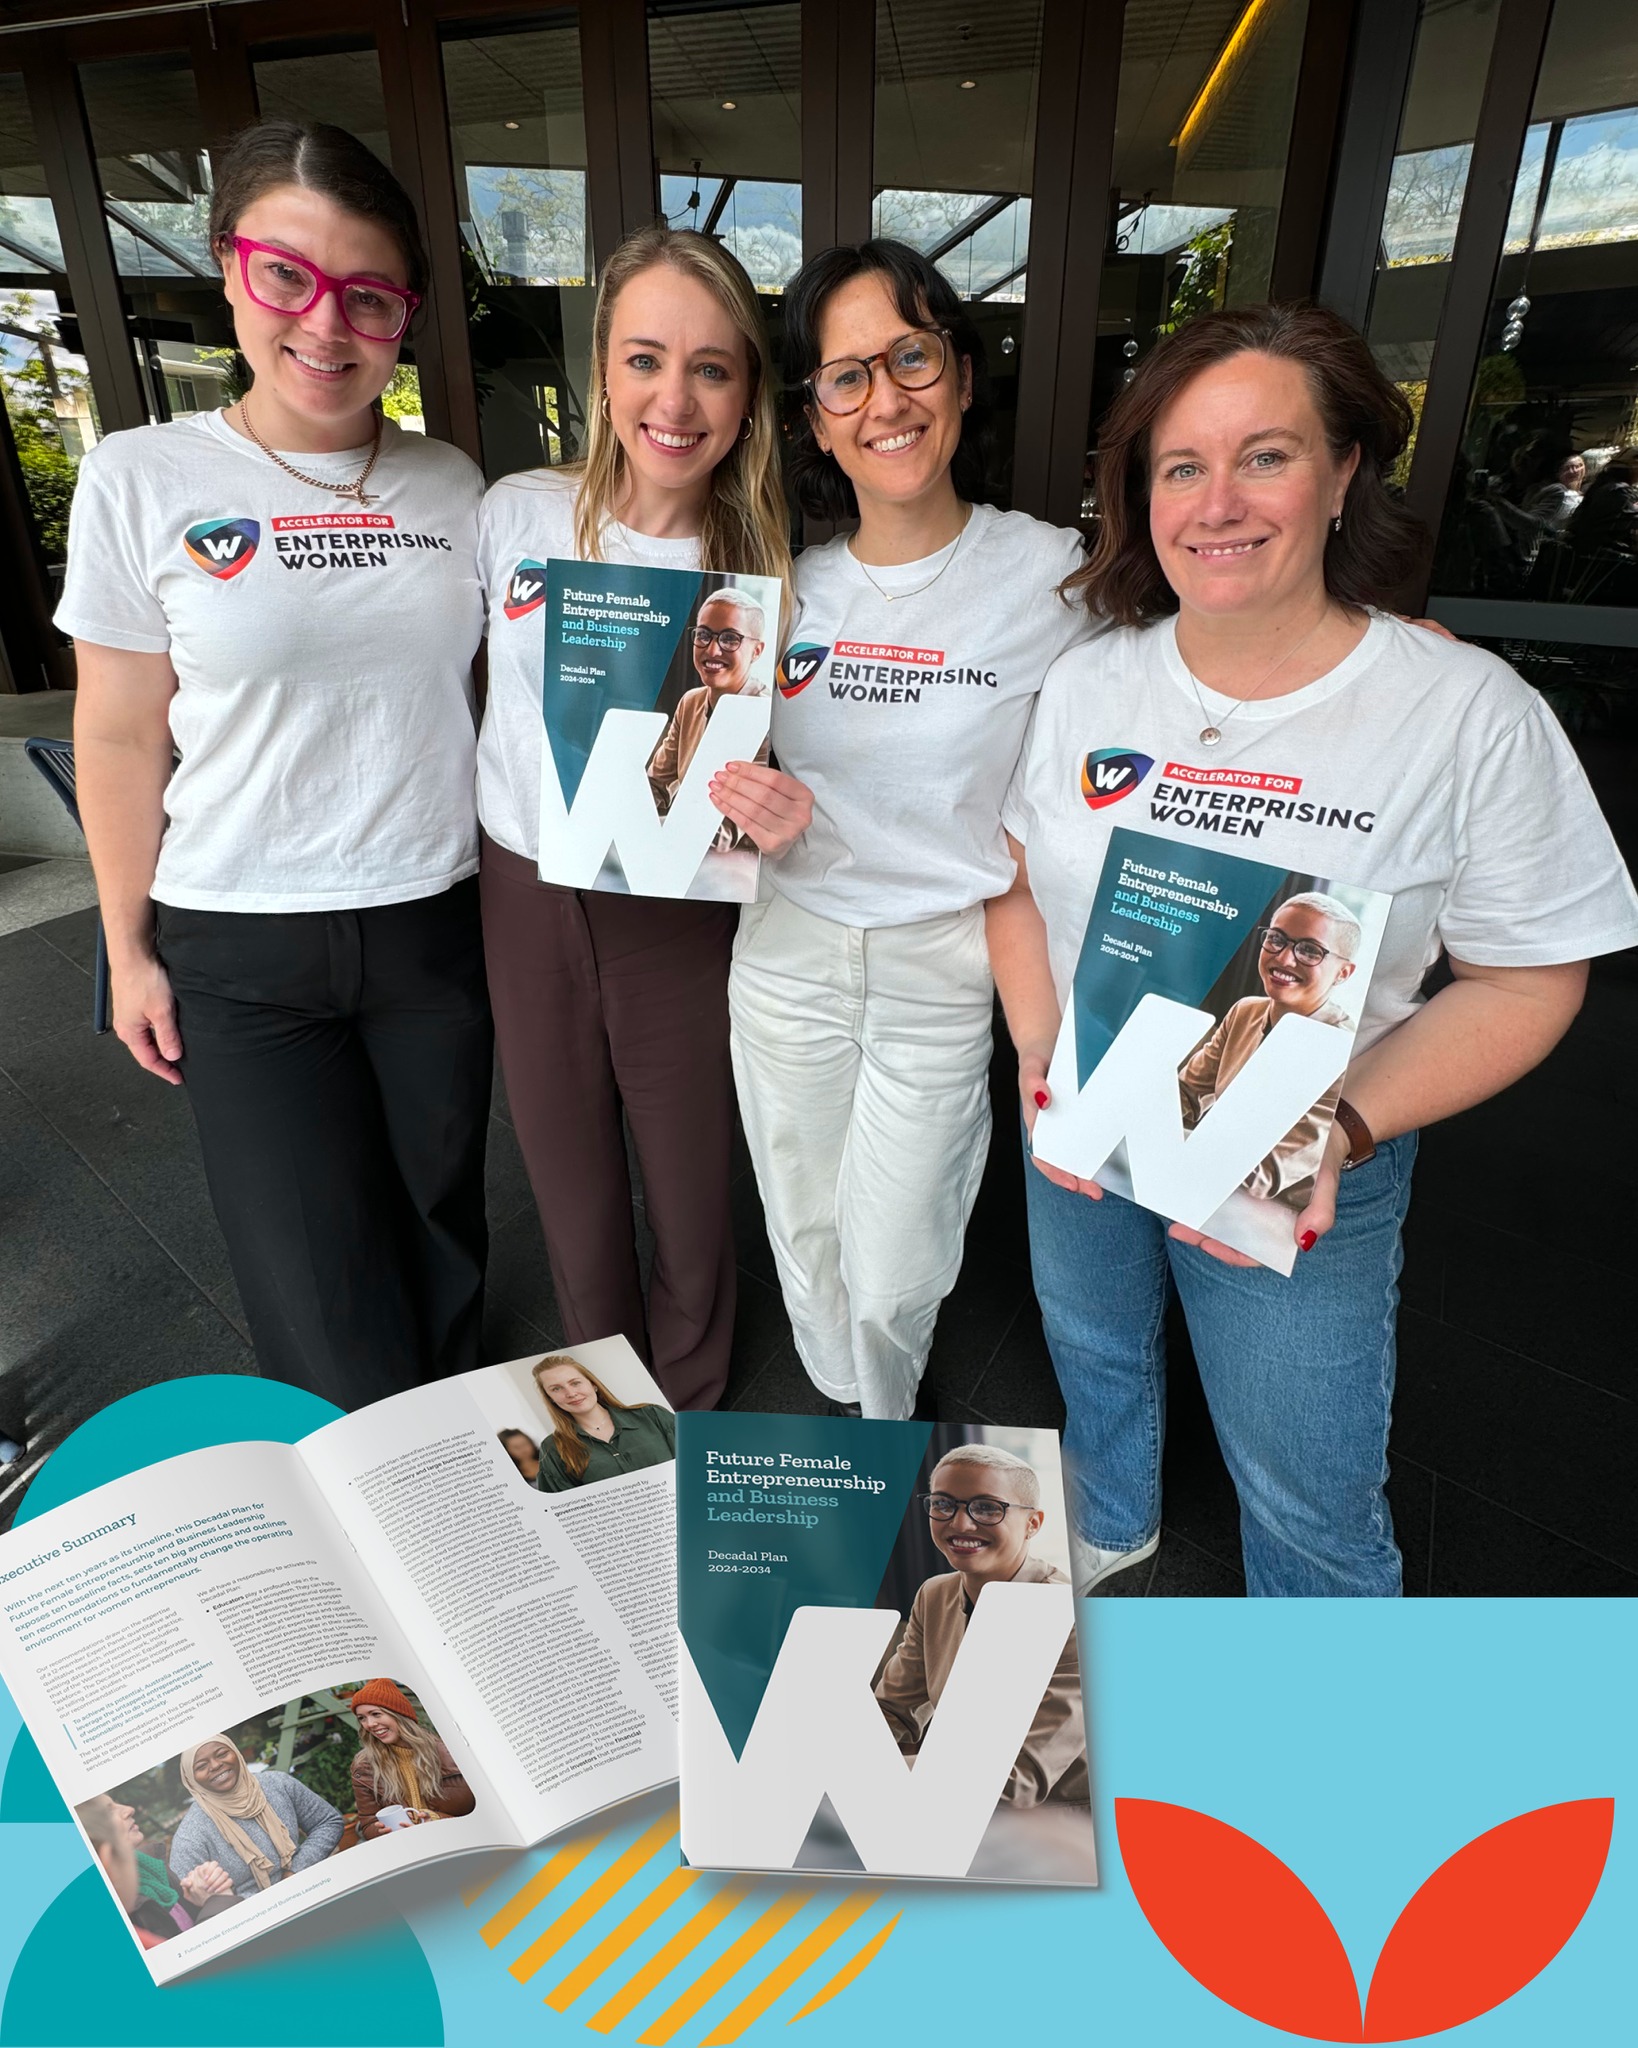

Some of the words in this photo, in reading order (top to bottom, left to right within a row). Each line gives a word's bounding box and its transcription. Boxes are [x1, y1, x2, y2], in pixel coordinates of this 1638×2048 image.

[279, 516, 363, 529] ACCELERATOR
[366, 516, 390, 526] FOR
[204, 537, 240, 560] W
[275, 533, 452, 551] ENTERPRISING
[279, 552, 387, 570] WOMEN
[511, 576, 543, 601] W
[563, 588, 604, 603] Future
[606, 592, 650, 608] Female
[562, 604, 670, 627] Entrepreneurship
[562, 619, 585, 631] and
[586, 621, 640, 636] Business
[561, 633, 626, 651] Leadership
[839, 644, 914, 660] ACCELERATOR
[917, 653, 939, 662] FOR
[560, 664, 588, 675] Decadal
[590, 666, 606, 676] Plan
[560, 674, 596, 684] 2024-2034
[789, 658, 817, 681] W
[829, 662, 998, 688] ENTERPRISING
[828, 682, 921, 703] WOMEN
[1096, 763, 1131, 790] W
[1169, 767, 1261, 786] ACCELERATOR
[1265, 777, 1295, 790] FOR
[538, 693, 770, 898] W
[1153, 783, 1376, 833] ENTERPRISING
[1150, 803, 1264, 838] WOMEN
[1121, 858, 1166, 881] Future
[1169, 871, 1219, 895] Female
[1114, 888, 1140, 905] and
[1140, 895, 1200, 923] Business
[1118, 873, 1238, 919] Entrepreneurship
[1110, 902, 1182, 936] Leadership
[1100, 944, 1139, 963] 2024-2034
[1103, 934, 1136, 952] Decadal
[1134, 944, 1152, 957] Plan
[1033, 992, 1355, 1230] W
[706, 1451, 775, 1467] Future
[779, 1453, 851, 1470] Female
[706, 1469, 886, 1494] Entrepreneurship
[707, 1489, 745, 1503] and
[750, 1490, 839, 1507] Business
[707, 1508, 819, 1529] Leadership
[0, 1549, 61, 1584] xecutive
[62, 1513, 136, 1552] Summary
[4, 1600, 26, 1612] With
[27, 1592, 42, 1602] the
[44, 1580, 64, 1594] next
[65, 1573, 82, 1583] ten
[82, 1560, 108, 1577] years
[109, 1555, 120, 1563] as
[120, 1549, 132, 1557] its
[133, 1532, 174, 1551] timeline,
[174, 1524, 193, 1534] this
[193, 1510, 230, 1527] Decadal
[231, 1506, 251, 1514] Plan
[708, 1550, 757, 1561] Decadal
[760, 1552, 788, 1562] Plan
[9, 1606, 39, 1622] Future
[40, 1589, 73, 1608] Female
[75, 1551, 155, 1591] Entrepreneurship
[157, 1541, 175, 1553] and
[175, 1527, 216, 1545] Business
[217, 1513, 265, 1530] Leadership
[15, 1612, 50, 1632] exposes
[51, 1604, 67, 1614] ten
[67, 1585, 106, 1606] baseline
[107, 1574, 133, 1587] facts,
[133, 1564, 153, 1575] sets
[153, 1556, 170, 1566] ten
[170, 1549, 187, 1559] big
[188, 1533, 233, 1552] ambitions
[234, 1526, 251, 1536] and
[252, 1520, 287, 1531] outlines
[708, 1564, 771, 1574] 2024-2034
[19, 1632, 35, 1642] ten
[36, 1591, 119, 1634] recommendations
[131, 1556, 197, 1588] fundamentally
[199, 1544, 233, 1559] change
[234, 1539, 250, 1547] the
[251, 1529, 293, 1542] operating
[25, 1621, 82, 1651] environment
[83, 1614, 96, 1623] for
[98, 1597, 133, 1616] women
[135, 1567, 202, 1598] entrepreneurs.
[76, 1716, 103, 1731] leverage
[103, 1710, 114, 1718] the
[115, 1693, 146, 1712] untapped
[146, 1669, 194, 1696] entrepreneurial
[194, 1661, 213, 1672] talent
[81, 1706, 105, 1721] achieve
[145, 1673, 172, 1689] Australia
[172, 1664, 192, 1675] needs
[87, 1720, 111, 1734] women
[112, 1712, 124, 1722] and
[162, 1684, 182, 1696] needs
[189, 1673, 203, 1682] cast
[83, 1722, 123, 1744] responsibility
[125, 1711, 144, 1723] across
[678, 1581, 1075, 1877] W
